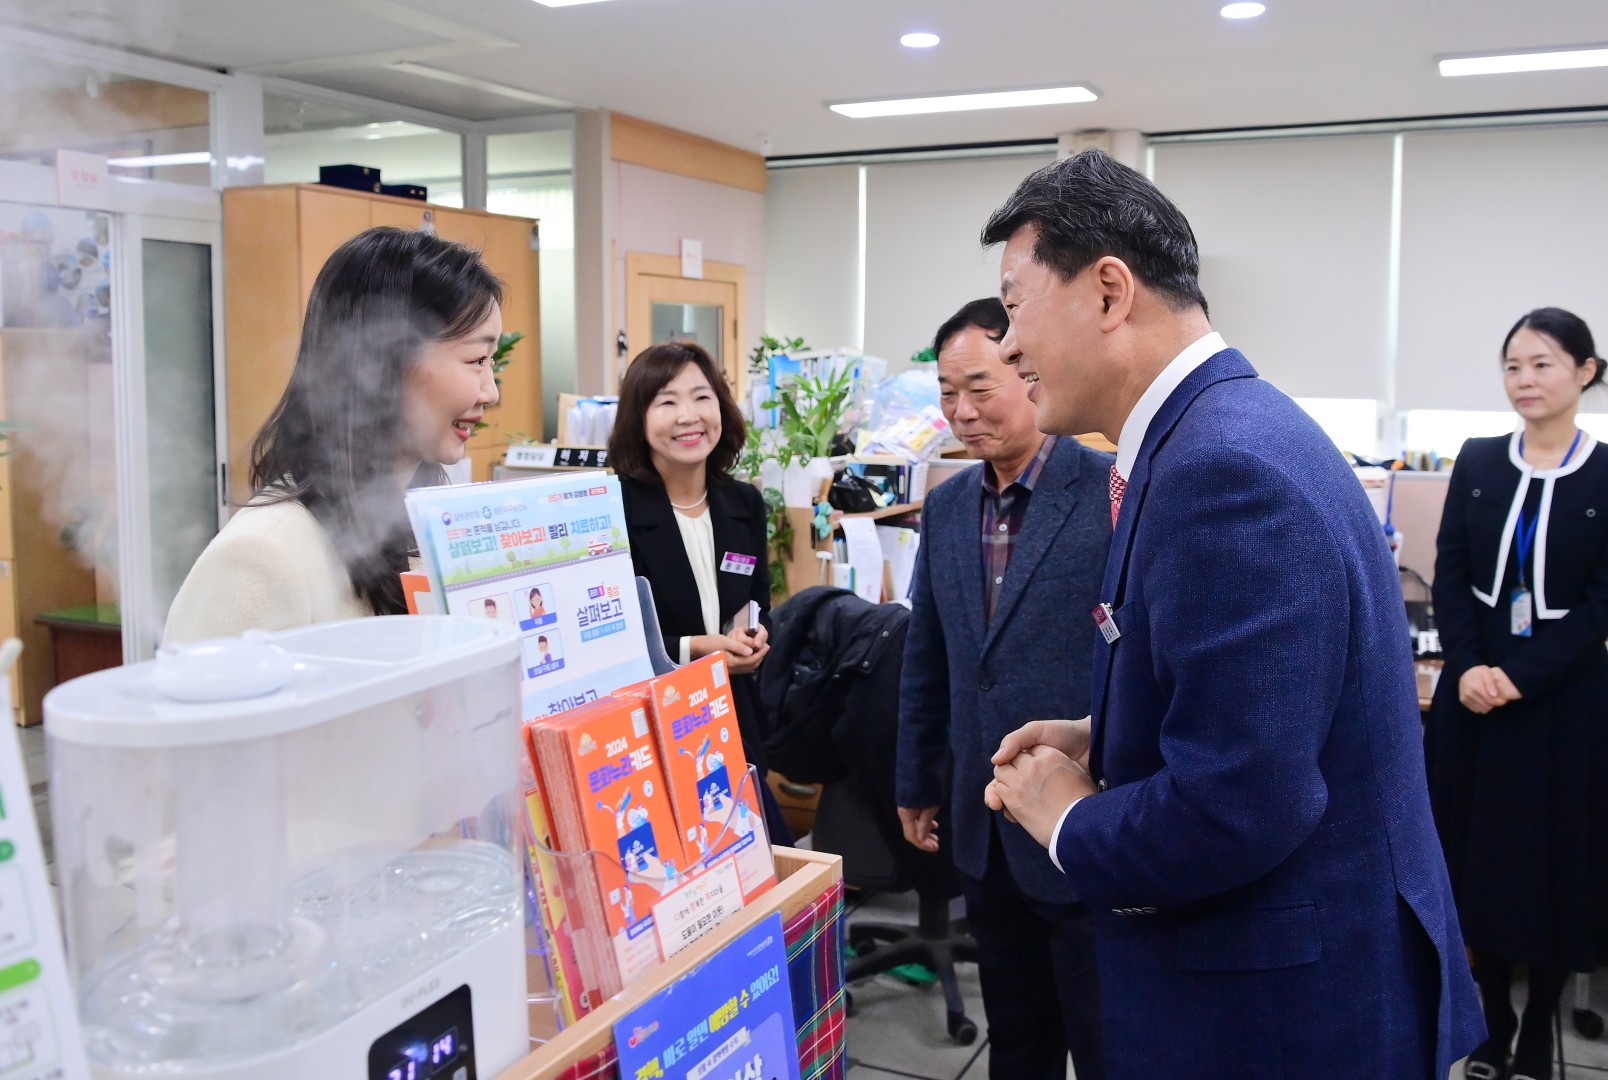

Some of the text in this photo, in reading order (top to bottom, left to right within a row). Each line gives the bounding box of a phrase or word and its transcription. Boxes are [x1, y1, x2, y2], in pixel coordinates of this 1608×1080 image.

[449, 514, 612, 559] 살펴보고! 찾아보고! 빨리 치료하고!
[577, 598, 624, 628] 살펴보고
[672, 694, 730, 741] 문화누리카드
[688, 687, 708, 708] 2024
[588, 744, 654, 794] 문화누리카드
[605, 736, 628, 758] 2024
[662, 1036, 688, 1069] 바로
[687, 1018, 709, 1052] 알면
[708, 995, 739, 1034] 예방할
[740, 989, 750, 1008] 수
[750, 964, 780, 1002] 있어요!
